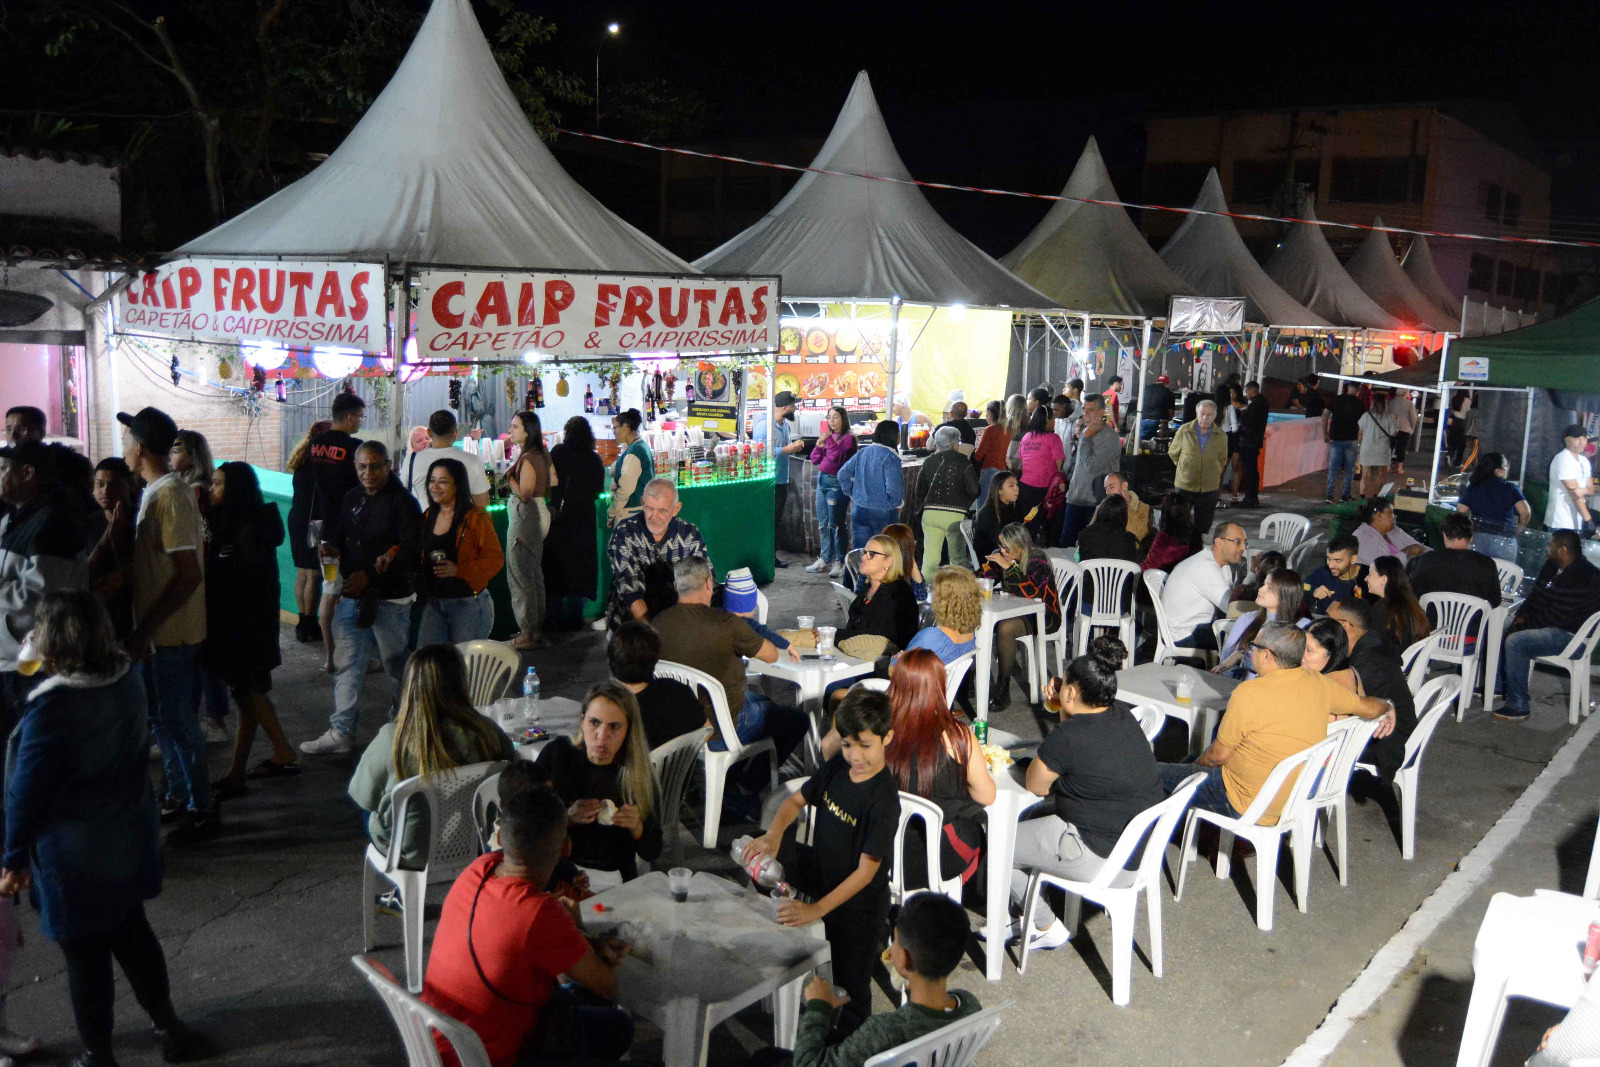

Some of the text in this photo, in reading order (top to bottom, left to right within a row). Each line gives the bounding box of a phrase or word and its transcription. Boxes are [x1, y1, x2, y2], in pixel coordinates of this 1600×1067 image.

[213, 267, 371, 322] FRUTAS
[431, 279, 768, 329] CAIP FRUTAS
[125, 307, 209, 331] CAPETÃO
[212, 313, 220, 333] &
[429, 325, 566, 351] CAPETÃO
[584, 332, 601, 348] &
